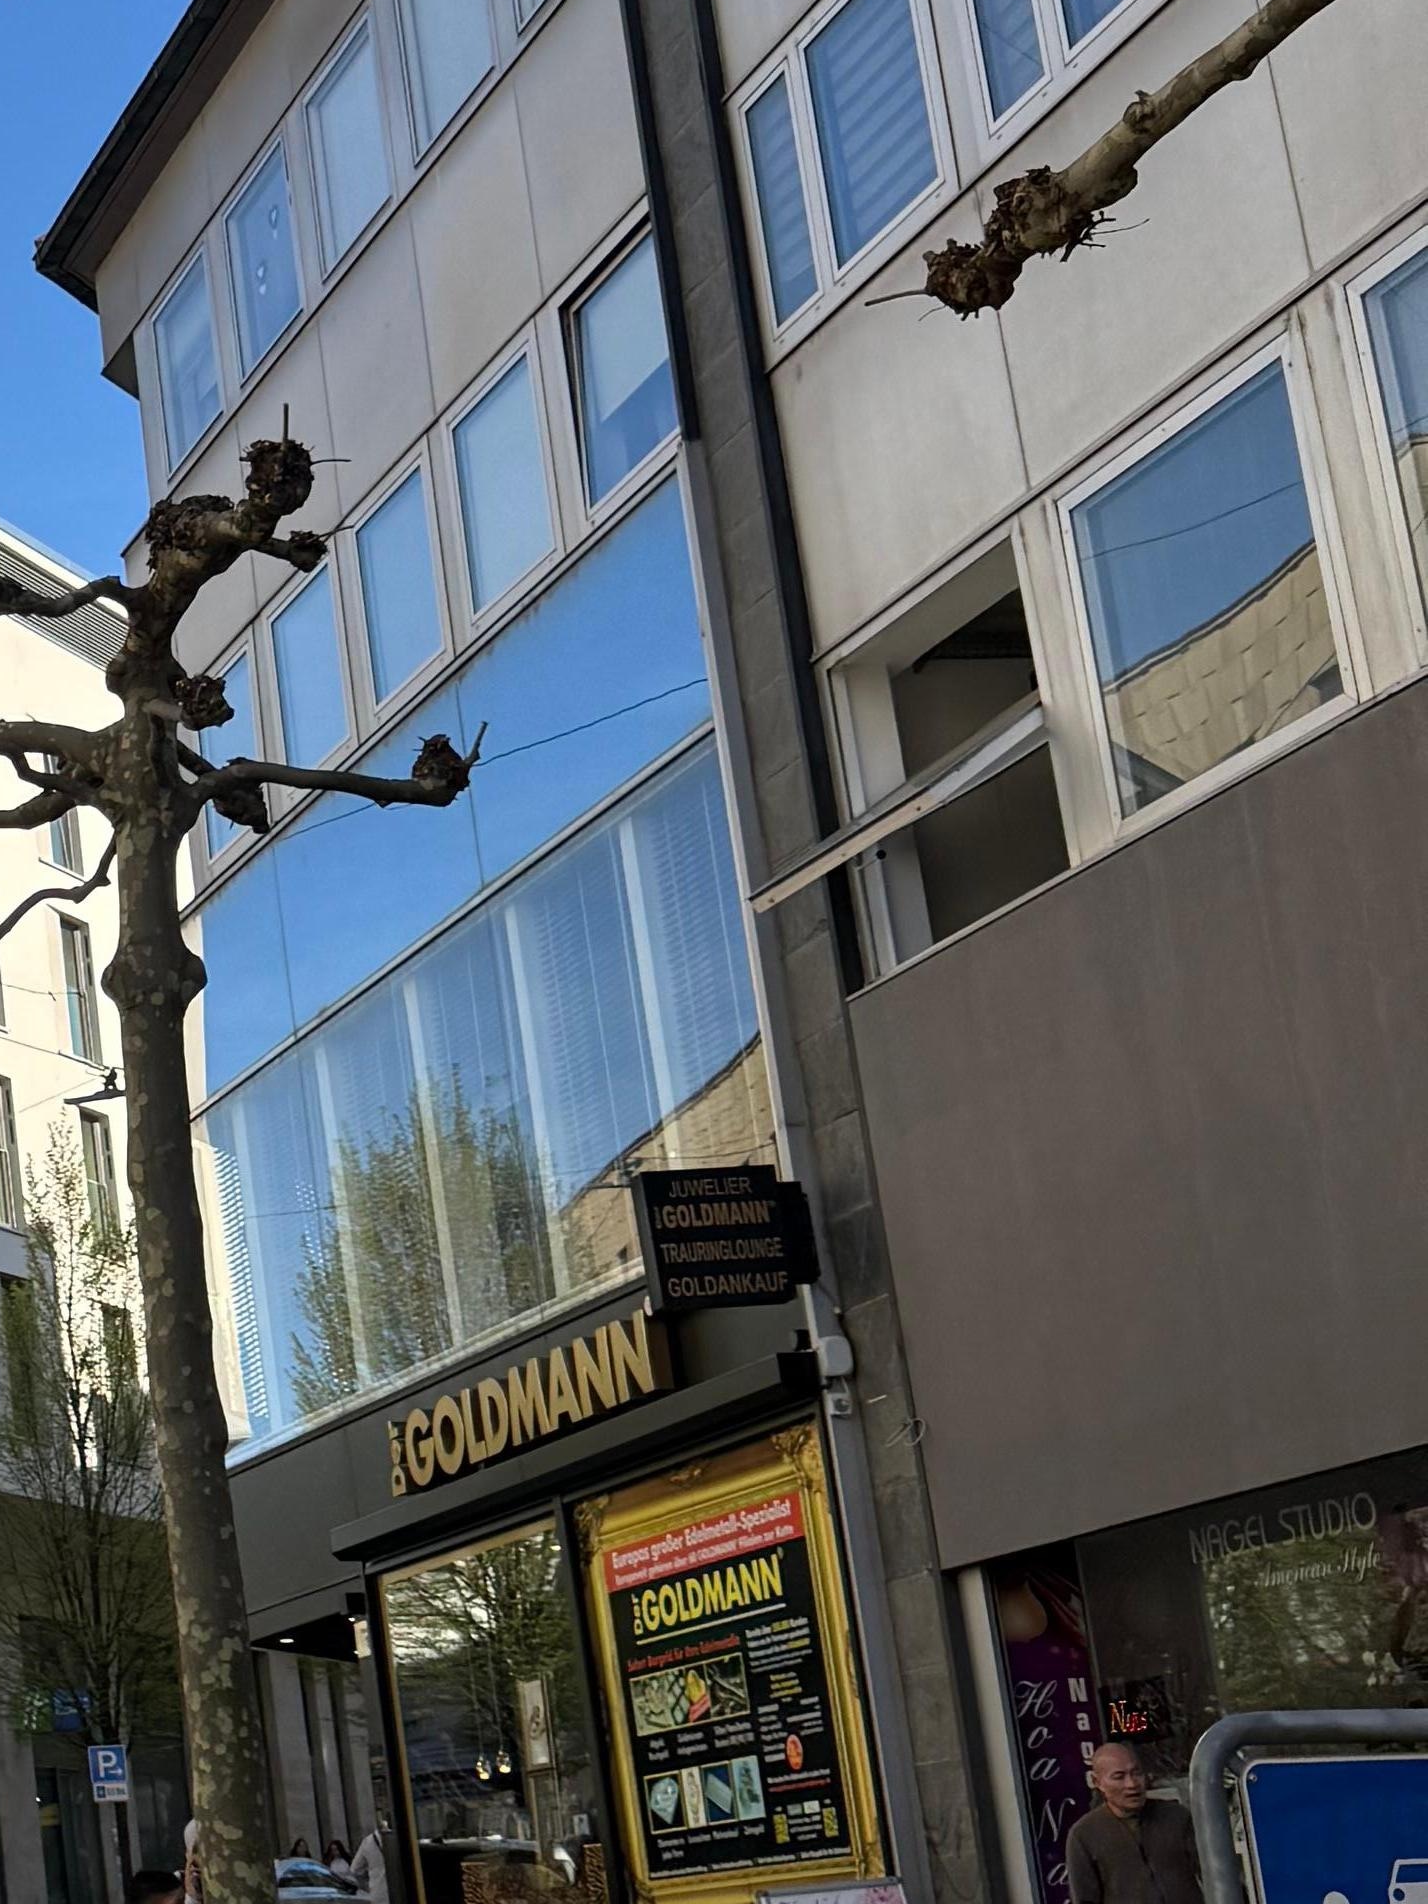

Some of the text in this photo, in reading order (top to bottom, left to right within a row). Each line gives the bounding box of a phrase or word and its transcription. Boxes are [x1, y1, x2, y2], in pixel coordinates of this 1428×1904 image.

[669, 1177, 752, 1198] JUWELIER
[662, 1200, 771, 1228] GOLDMANN
[660, 1237, 784, 1264] TRAURINGLOUNGE
[668, 1271, 788, 1297] GOLDANKAUF
[404, 1308, 656, 1487] GOLDMANN
[1188, 1492, 1378, 1565] NAGEL STUDIO
[631, 1553, 784, 1636] Der GOLDMANN
[97, 1750, 118, 1778] P
